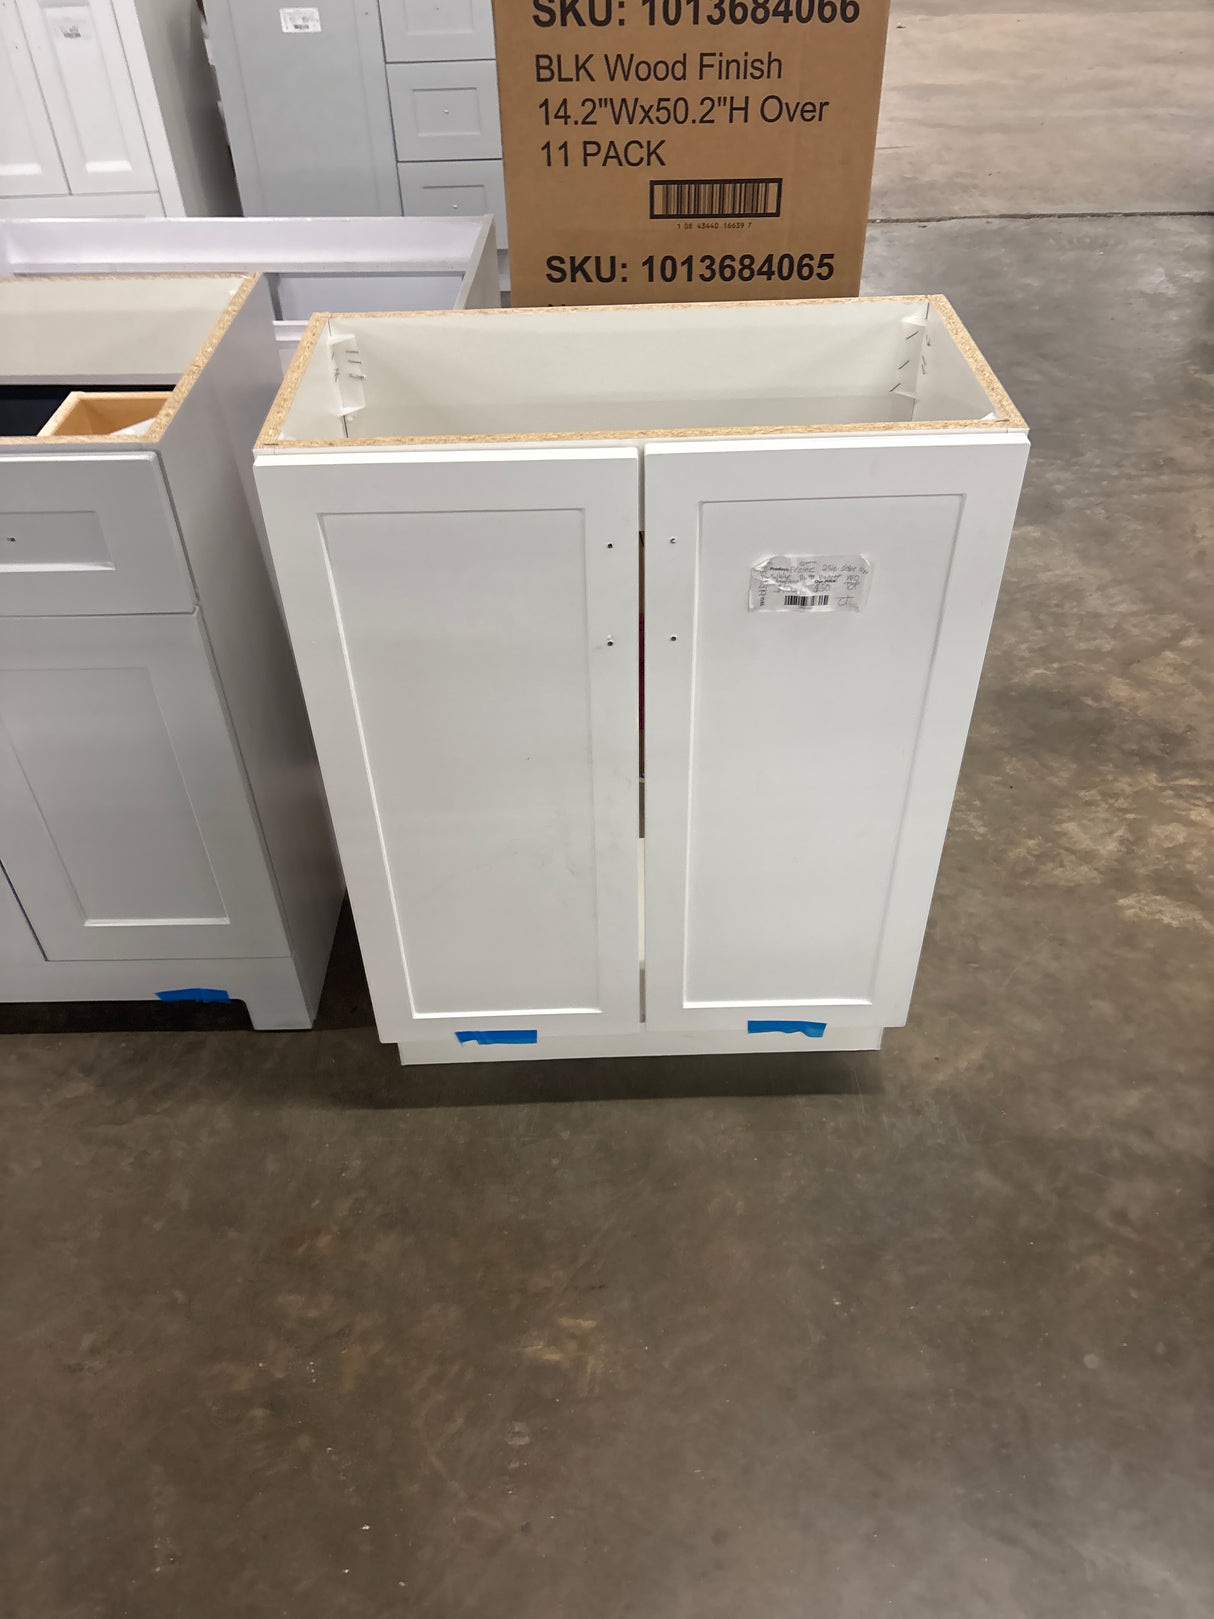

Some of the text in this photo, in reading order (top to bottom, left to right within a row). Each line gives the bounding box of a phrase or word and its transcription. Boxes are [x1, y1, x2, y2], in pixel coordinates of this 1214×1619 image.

[532, 0, 860, 27] SKU: 1013684066
[535, 51, 783, 83] BLK Wood Finish
[538, 94, 830, 126] 14.2"Wx50.2"H Over
[540, 139, 666, 167] 11 PACK
[545, 253, 835, 284] SKU: 1013684065
